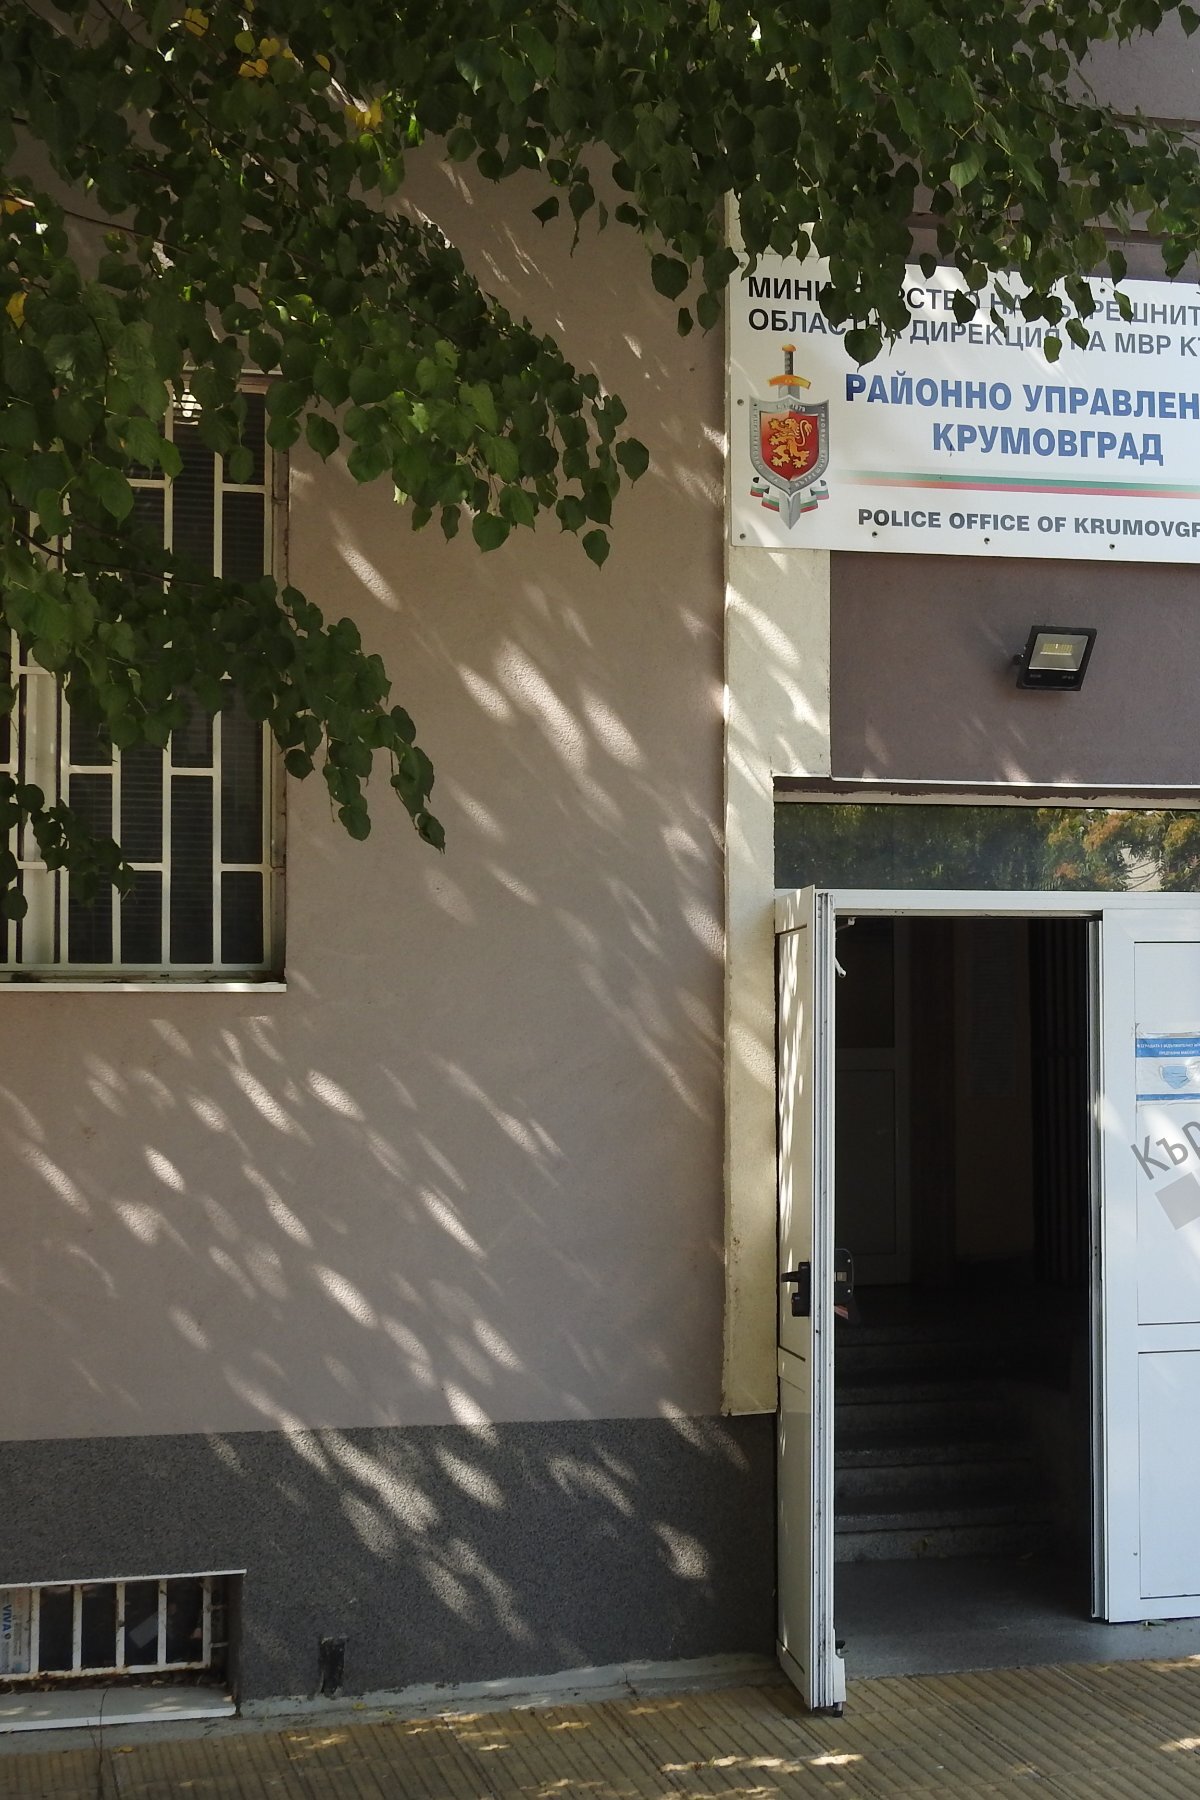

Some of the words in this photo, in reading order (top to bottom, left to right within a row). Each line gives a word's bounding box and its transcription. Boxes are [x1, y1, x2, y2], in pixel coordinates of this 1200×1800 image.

[748, 308, 903, 341] ОБЛАС
[1115, 331, 1172, 357] МВР
[846, 370, 1012, 411] РАЙОННО
[932, 422, 1164, 466] КРУМОВГРАД
[858, 508, 941, 528] POLICE
[949, 512, 1030, 532] OFFICE
[1037, 515, 1067, 533] OF
